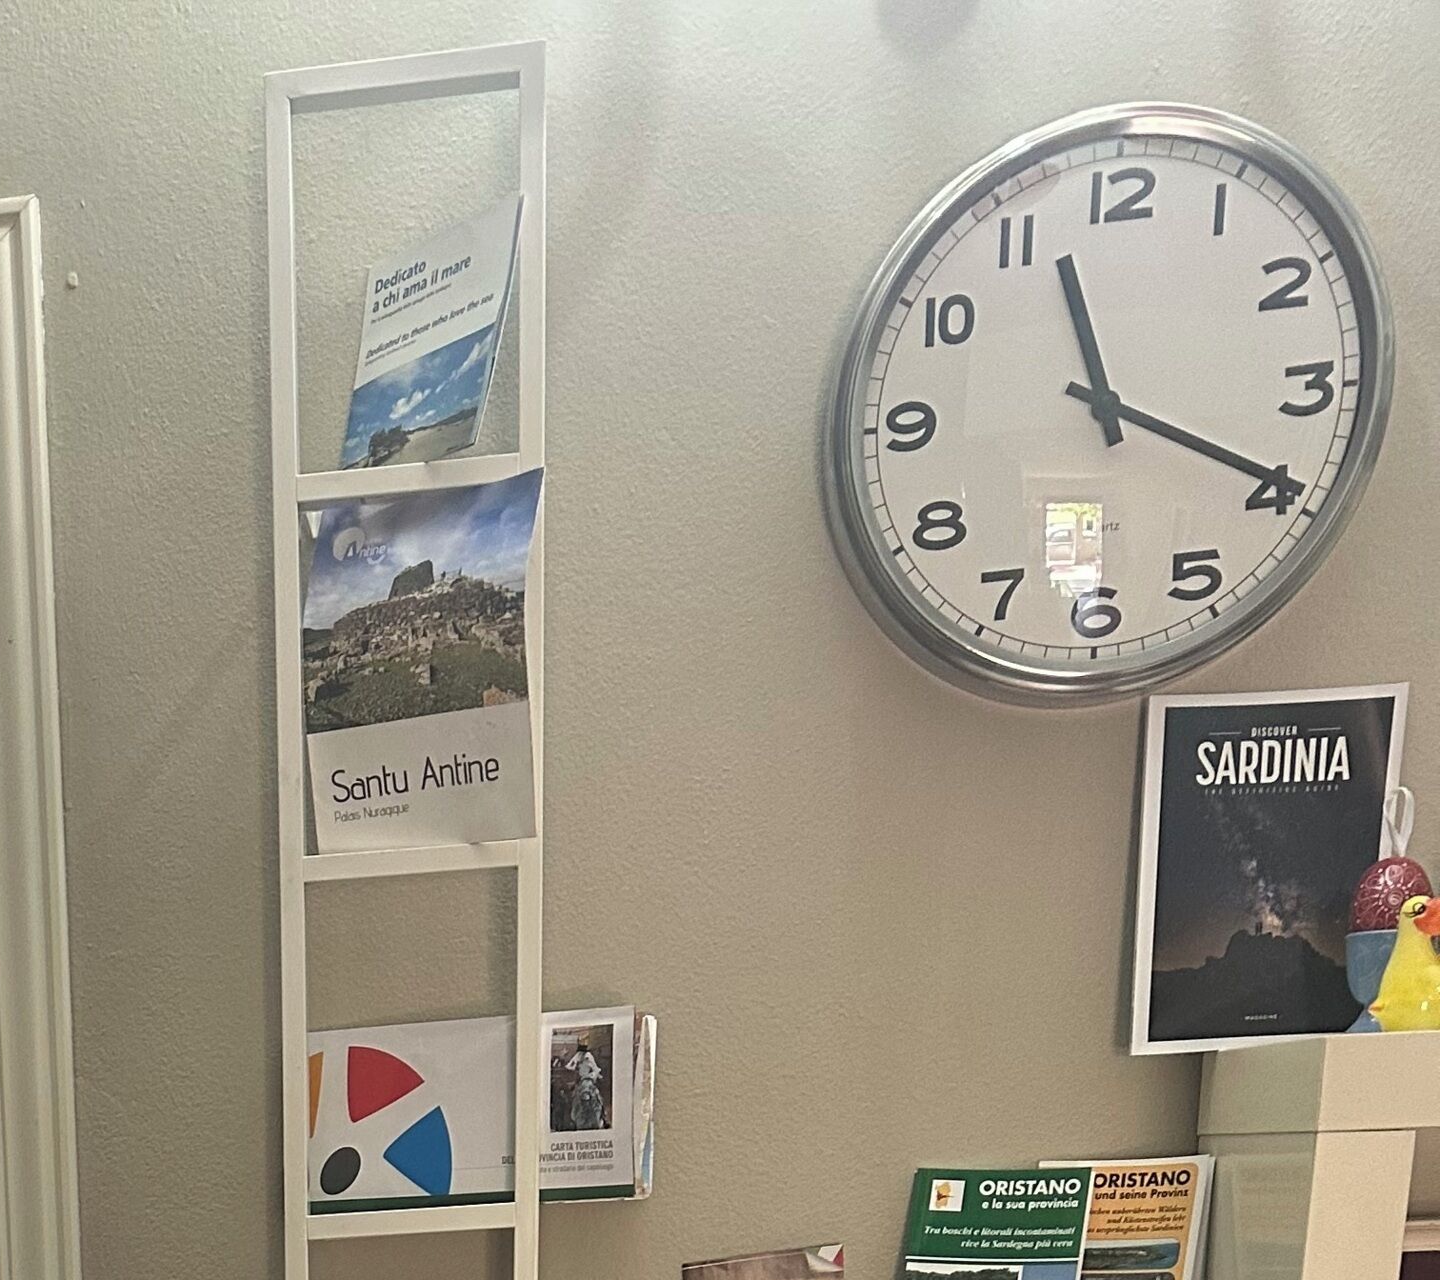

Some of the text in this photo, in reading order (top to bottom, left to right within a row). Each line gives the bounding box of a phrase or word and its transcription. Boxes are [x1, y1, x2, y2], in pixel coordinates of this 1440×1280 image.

[1090, 167, 1156, 224] 12
[1212, 183, 1227, 236] 1
[998, 214, 1034, 268] 11
[372, 300, 379, 313] a
[383, 288, 400, 309] chi
[402, 279, 427, 300] ama
[430, 268, 439, 286] il
[441, 256, 471, 281] mare
[375, 261, 426, 294] Dedicato
[1258, 257, 1311, 312] 2
[924, 294, 975, 348] 10
[1278, 360, 1334, 416] 3
[885, 401, 937, 452] 9
[1245, 464, 1298, 516] 4
[912, 501, 967, 550] 8
[981, 568, 1025, 621] 7
[1167, 548, 1222, 602] 5
[1071, 587, 1122, 638] 6
[1251, 726, 1298, 737] DISCOVER
[331, 753, 499, 802] Santu Antine
[1195, 736, 1351, 786] SARDINIA
[334, 809, 361, 823] Palais
[551, 1140, 614, 1152] CARTA TURISTICA
[577, 1150, 614, 1161] ORISTANO
[979, 1178, 1082, 1196] ORISTANO
[1093, 1170, 1191, 1188] ORISTANO
[1095, 1187, 1189, 1200] und seine Provinz
[982, 1197, 1079, 1212] e la sua provincia
[924, 1226, 941, 1235] Tra
[981, 1226, 1012, 1236] litorali
[1013, 1226, 1076, 1236] incontaminati
[981, 1238, 990, 1248] la
[992, 1239, 1034, 1250] Sardegna
